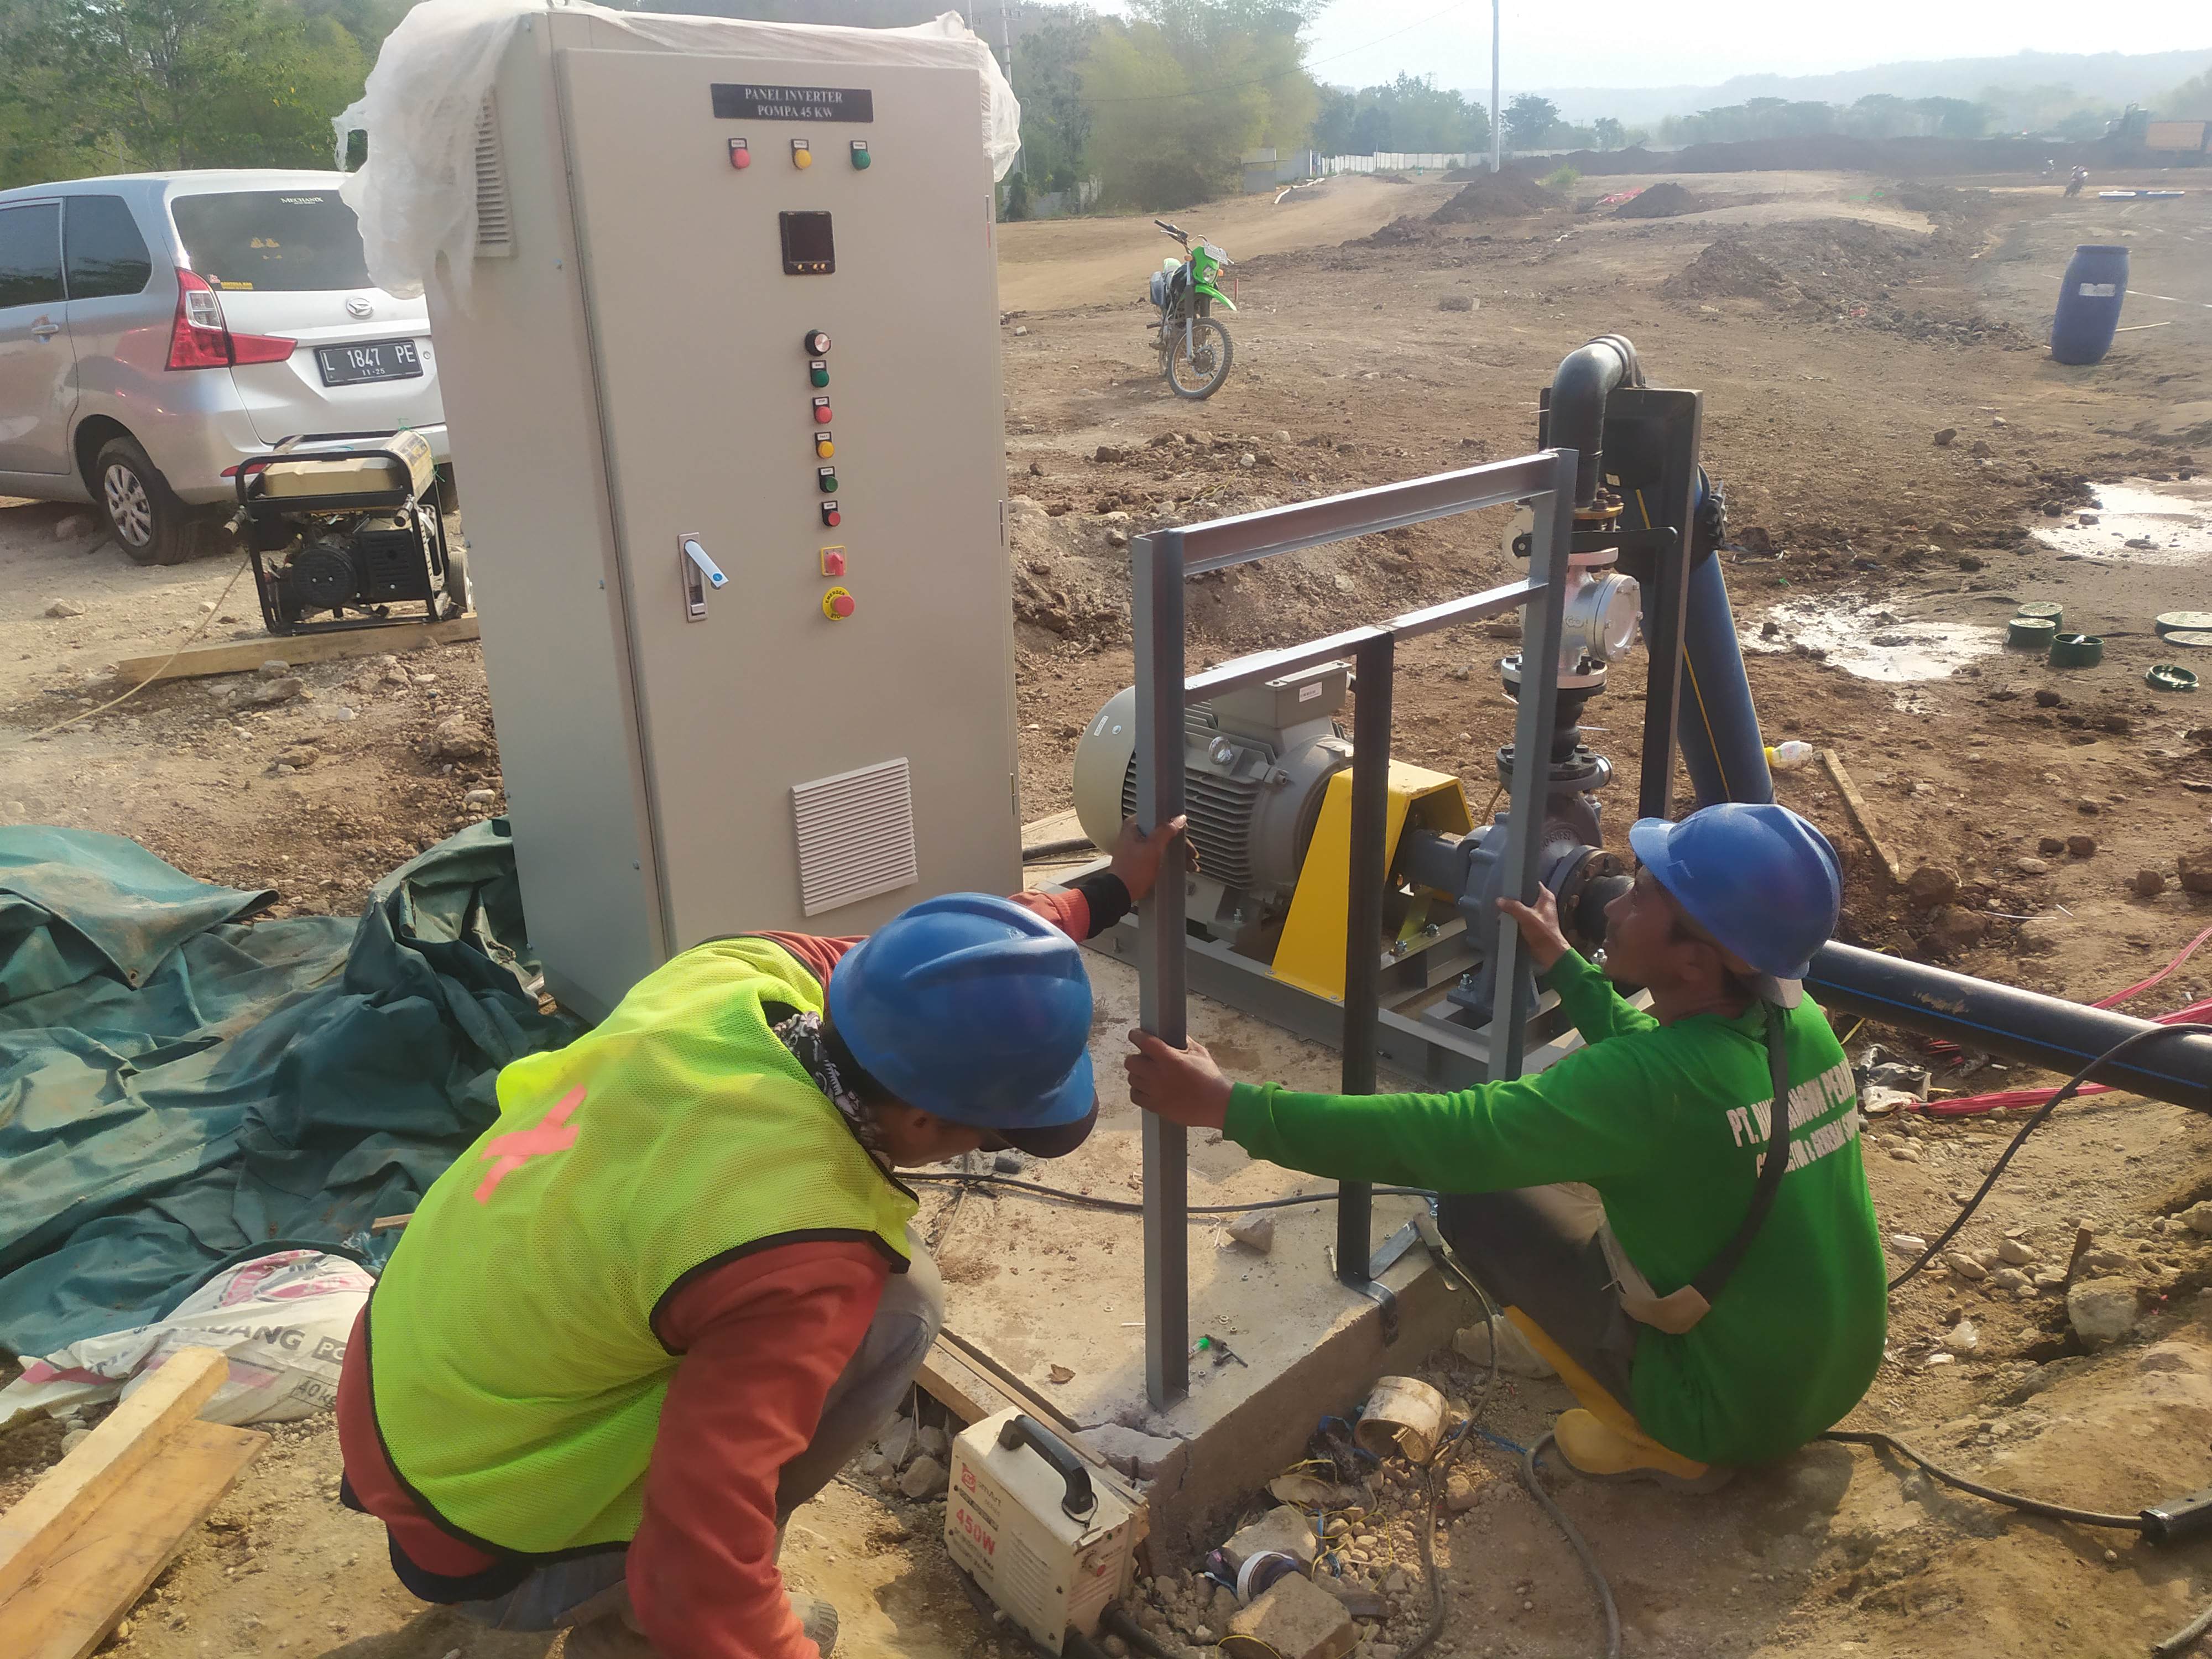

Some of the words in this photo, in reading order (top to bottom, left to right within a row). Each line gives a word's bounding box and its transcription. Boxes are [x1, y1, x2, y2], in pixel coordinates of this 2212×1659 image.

[745, 88, 782, 101] PANEL
[785, 90, 843, 103] INVERTER
[758, 105, 799, 117] POMPA
[801, 107, 812, 117] 45
[815, 107, 832, 118] KW
[324, 352, 335, 371] L
[347, 348, 380, 369] 1847
[395, 345, 416, 364] PE
[825, 590, 845, 604] EMERGEN
[1726, 1106, 1760, 1148] PT.
[956, 1509, 995, 1555] 450W
